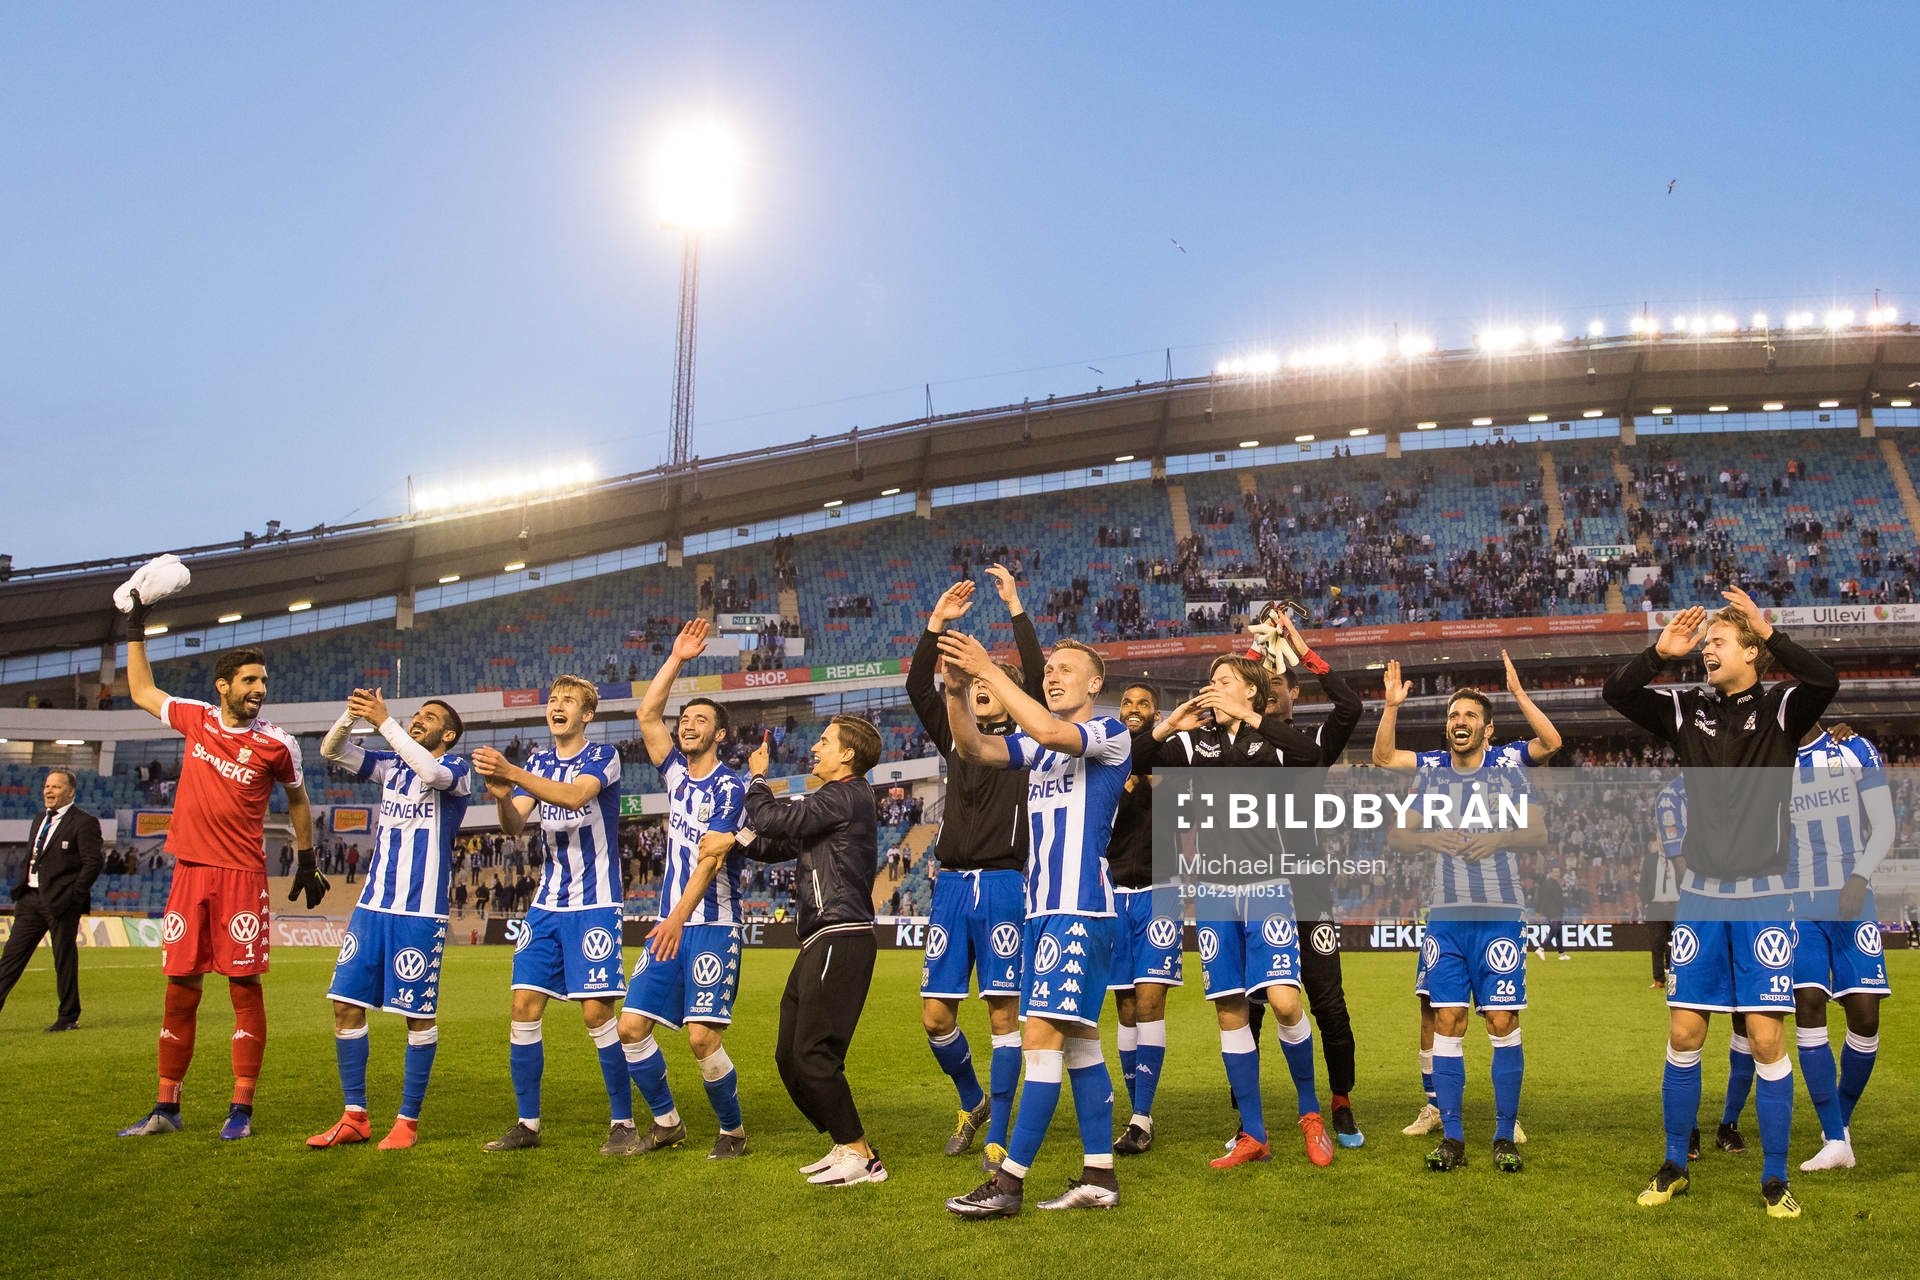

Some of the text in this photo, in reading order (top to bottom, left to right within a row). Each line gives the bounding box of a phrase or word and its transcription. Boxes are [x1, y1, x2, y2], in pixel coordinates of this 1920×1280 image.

[1813, 607, 1866, 623] Ullevi
[826, 662, 886, 680] REPEAT.
[671, 679, 699, 693] EET.
[745, 671, 789, 687] SHOP.
[1789, 787, 1850, 814] ERNEKE
[542, 804, 592, 821] ERNEKE
[277, 922, 344, 946] Scandic
[245, 943, 255, 957] 1
[1163, 956, 1172, 969] 5
[1272, 953, 1292, 969] 23
[588, 967, 609, 982] 14
[1006, 965, 1015, 980] 6
[1031, 980, 1051, 998] 24
[1496, 980, 1516, 995] 26
[1769, 975, 1790, 993] 19
[398, 988, 414, 1003] 16
[696, 992, 714, 1006] 22
[1029, 999, 1049, 1007] appa
[1760, 993, 1790, 1001] Kappa
